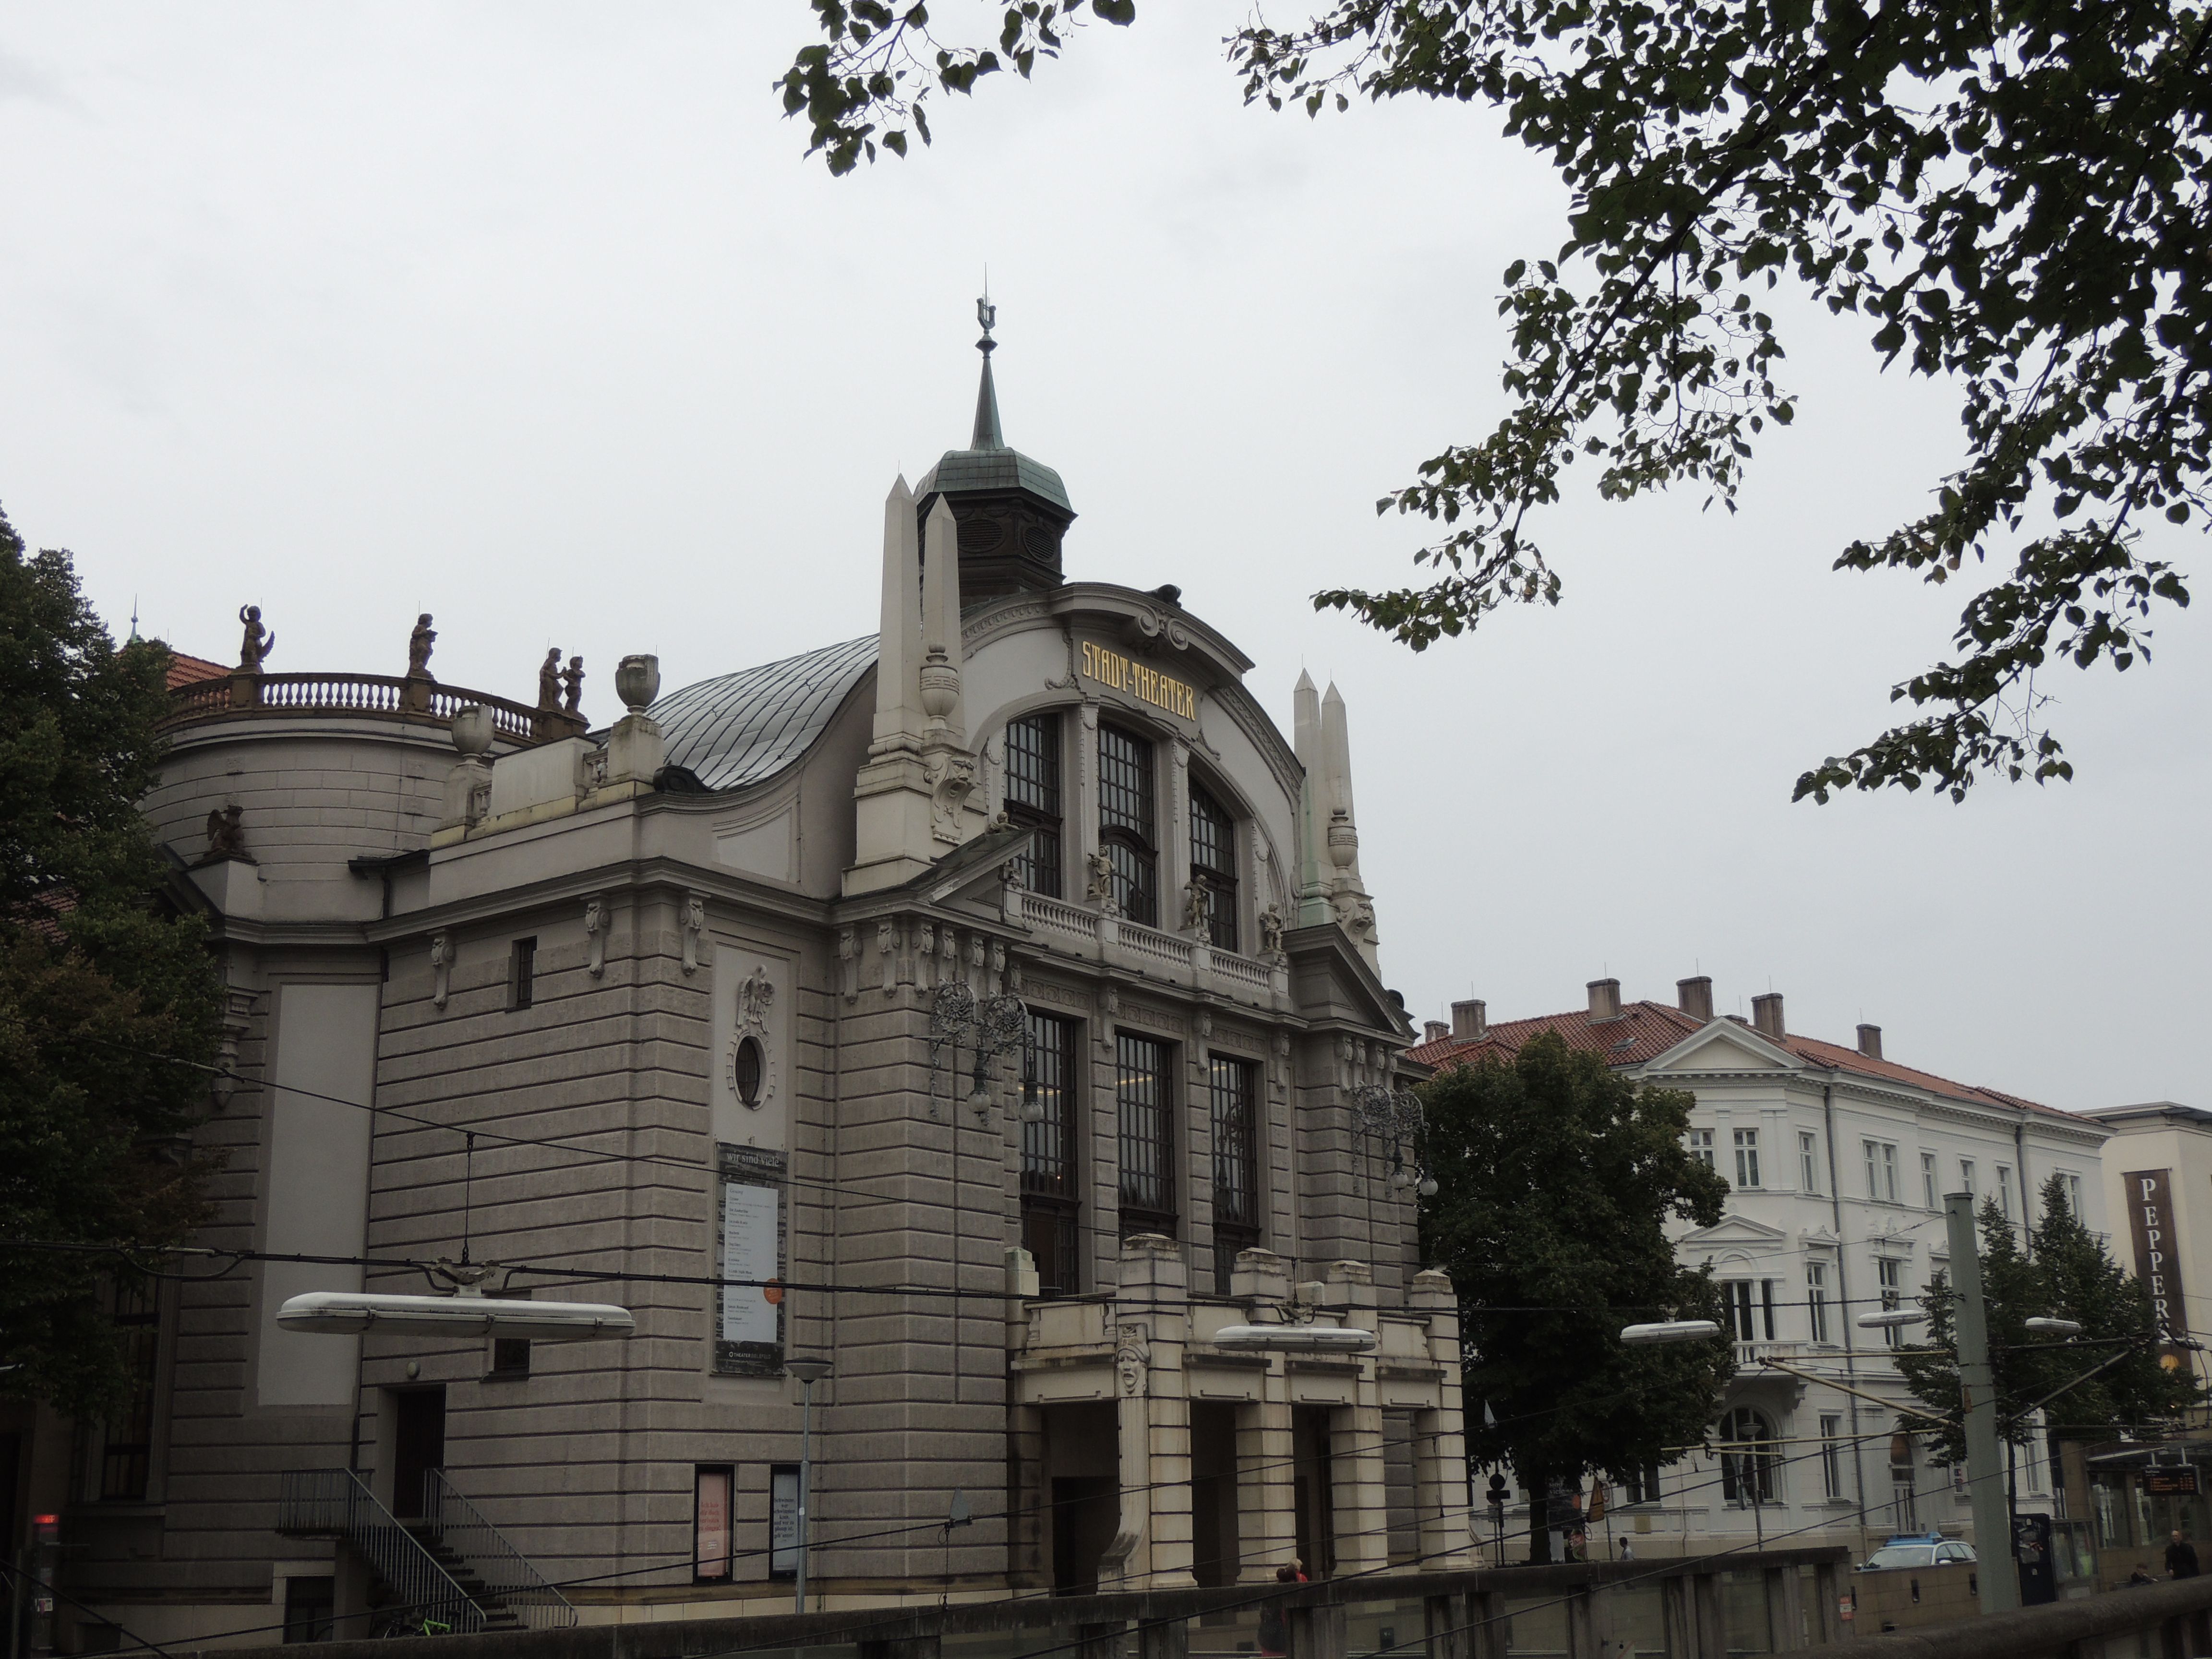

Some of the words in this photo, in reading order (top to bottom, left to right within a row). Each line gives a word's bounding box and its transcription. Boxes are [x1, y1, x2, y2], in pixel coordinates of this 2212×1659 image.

[1082, 640, 1195, 721] STADT-THEATER
[727, 1151, 740, 1162] wir
[742, 1153, 758, 1164] sind
[761, 1155, 779, 1167] viele
